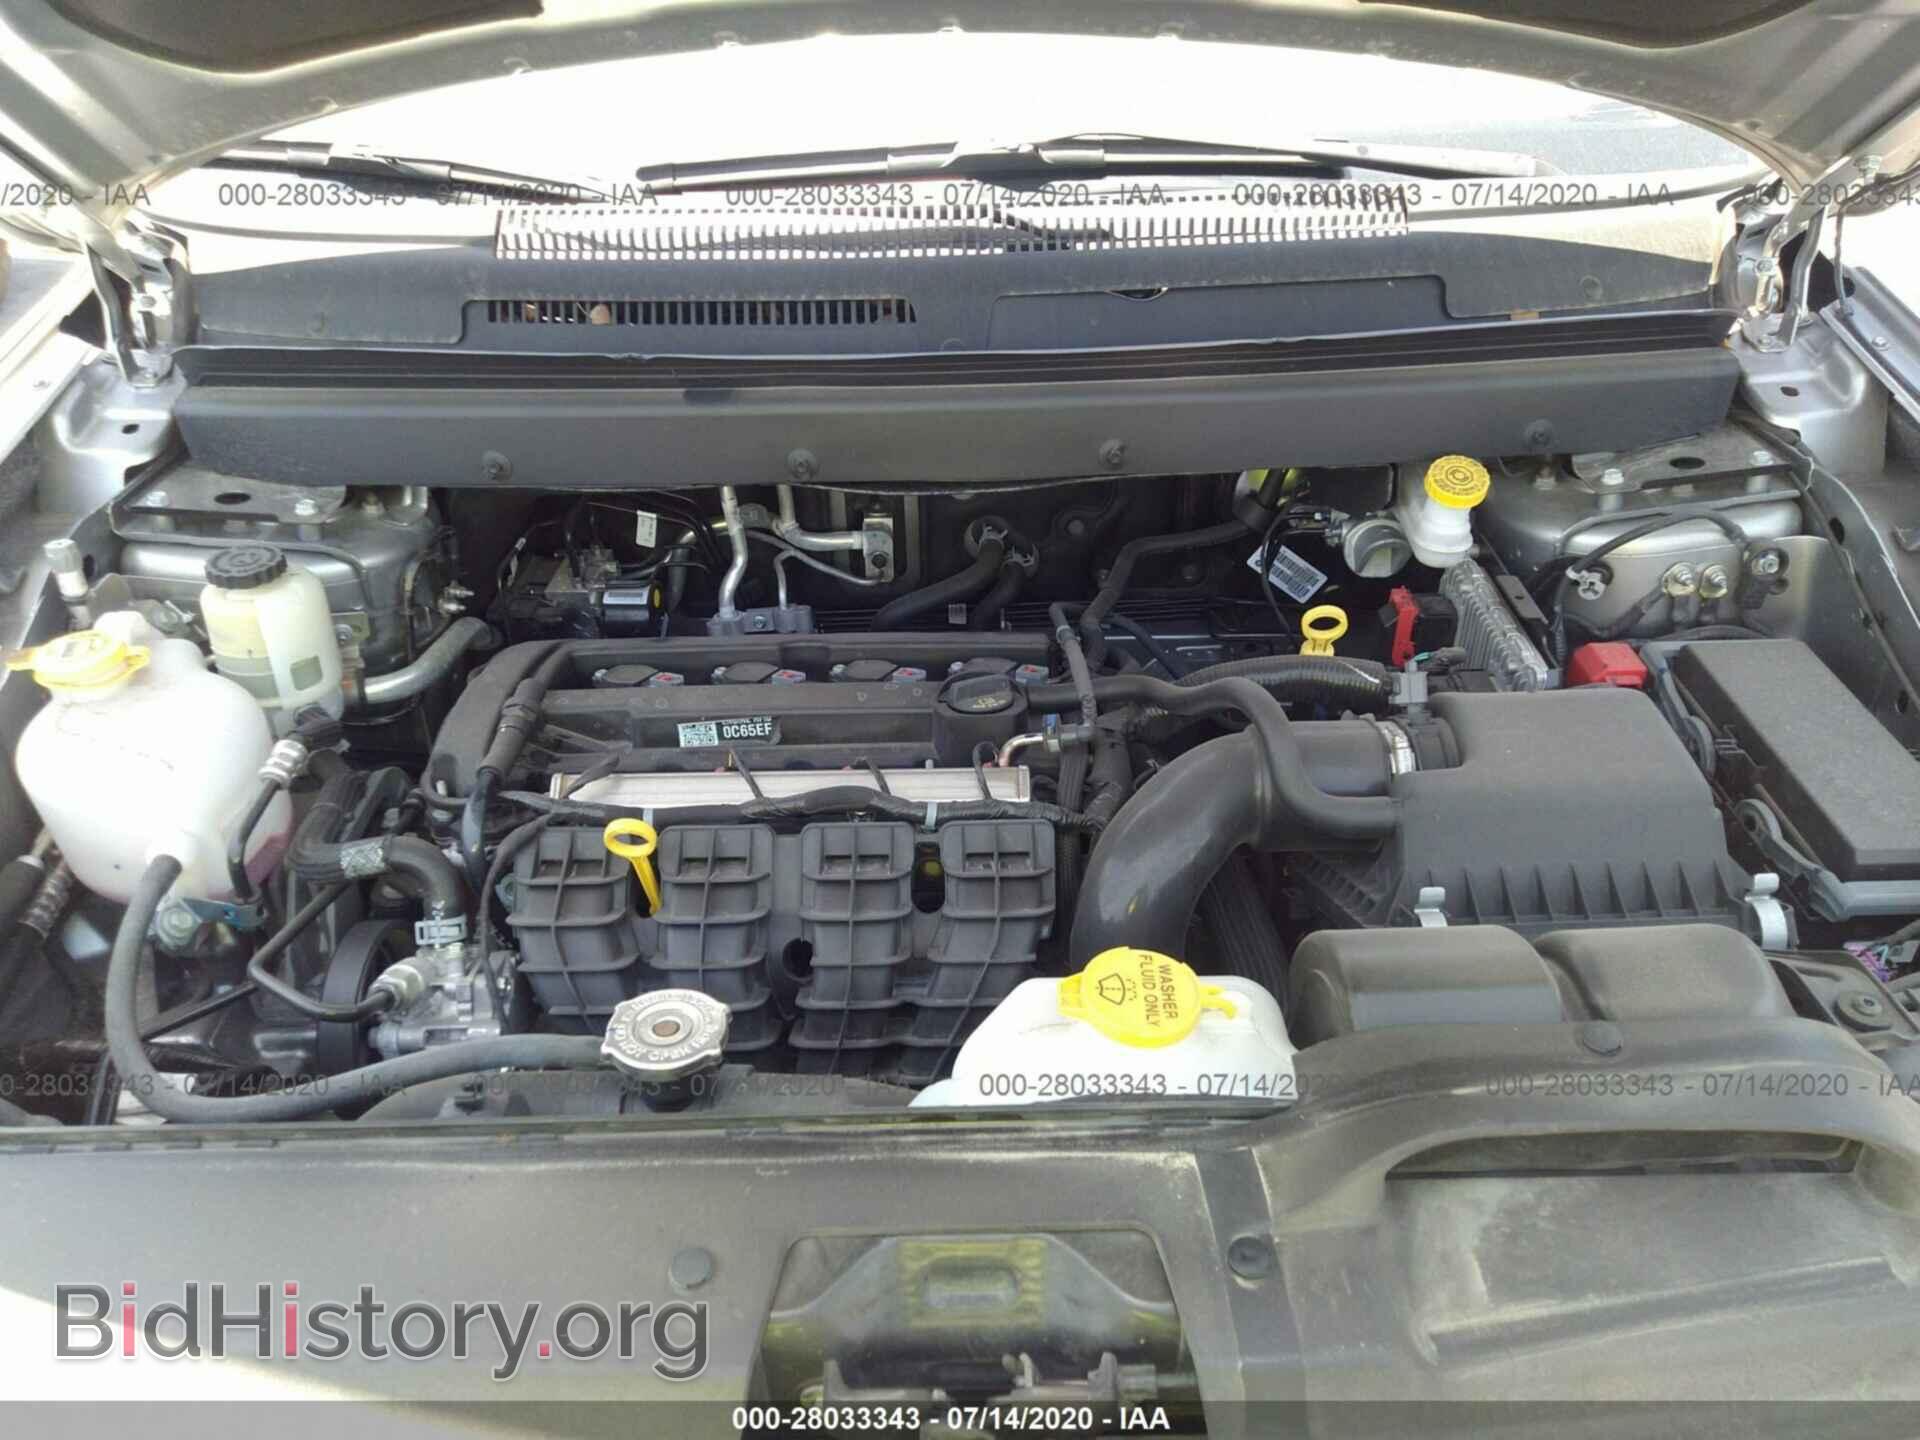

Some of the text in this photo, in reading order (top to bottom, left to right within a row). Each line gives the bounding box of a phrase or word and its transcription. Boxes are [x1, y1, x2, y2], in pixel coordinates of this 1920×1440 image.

[1138, 954, 1161, 1028] FLUID ONLY
[1158, 963, 1179, 1019] WASHER
